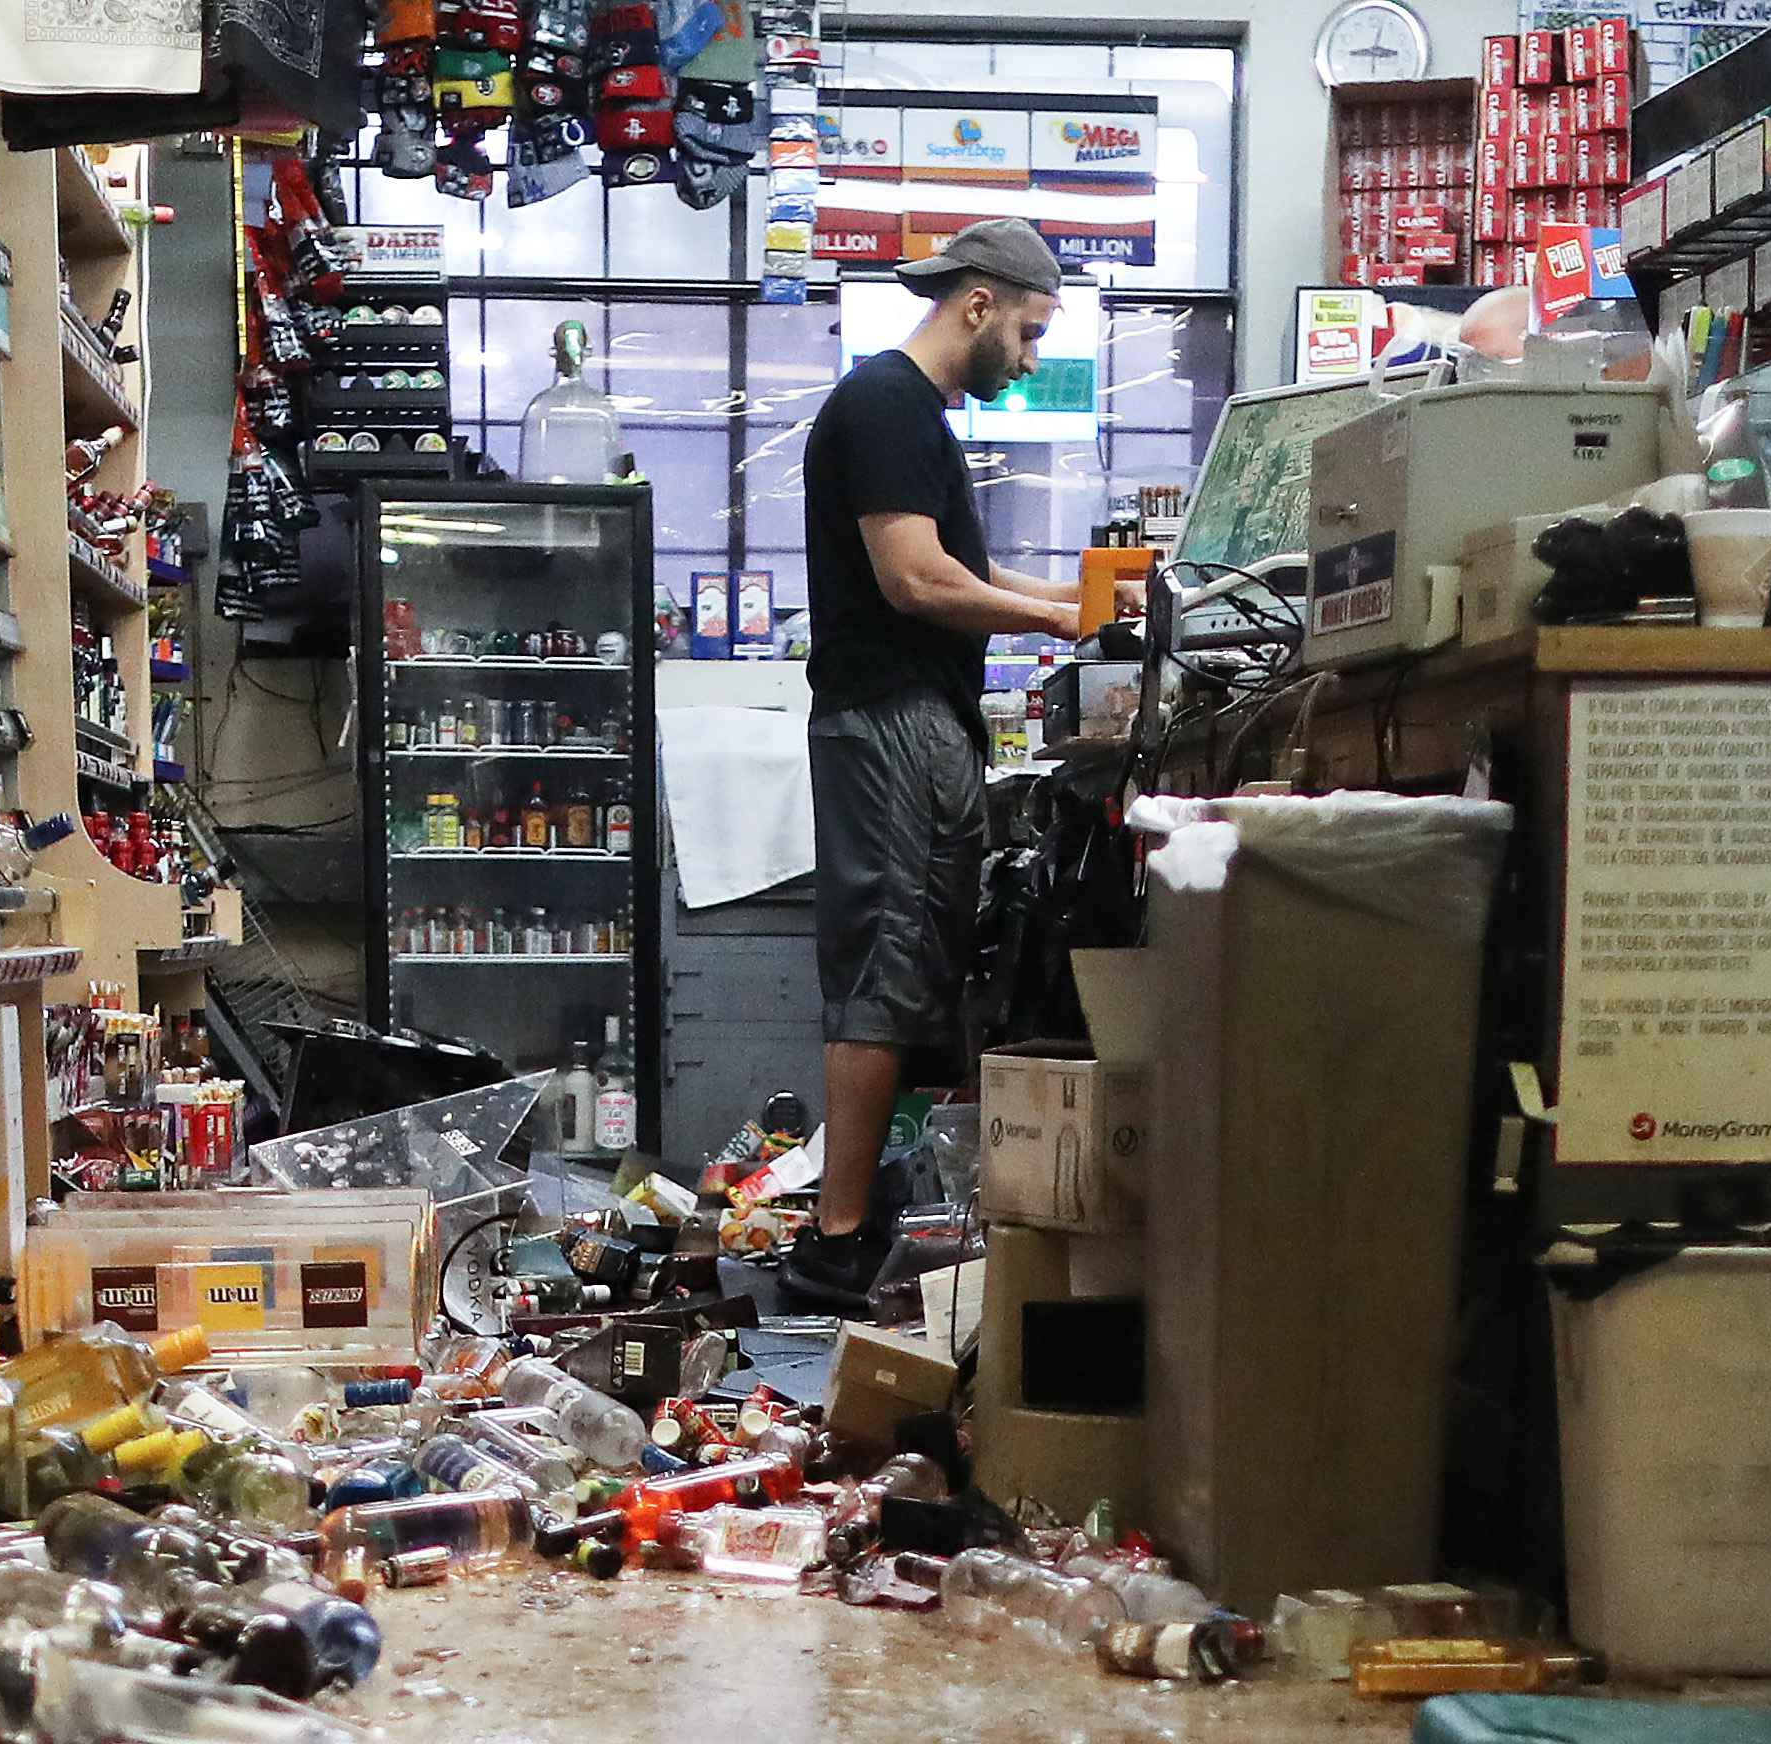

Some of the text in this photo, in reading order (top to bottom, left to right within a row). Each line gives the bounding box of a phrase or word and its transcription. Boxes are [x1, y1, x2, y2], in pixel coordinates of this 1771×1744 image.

[1491, 43, 1503, 85] CLASSIC
[1527, 36, 1540, 78] CLASSIC
[1574, 34, 1587, 76] CLASSIC
[1603, 24, 1615, 68] CLASSIC
[1488, 94, 1501, 136] CLASSIC
[1518, 93, 1529, 136] CLASSIC
[1549, 93, 1560, 134] CLASSIC
[1577, 88, 1588, 130] CLASSIC
[1604, 80, 1615, 125] CLASSIC
[1081, 124, 1139, 147] MEGA
[1484, 144, 1496, 186] CLASSIC
[1515, 142, 1527, 183] CLASSIC
[1546, 138, 1558, 180] CLASSIC
[1578, 140, 1589, 181] CLASSIC
[1606, 136, 1617, 179] CLASSIC
[1397, 216, 1439, 227] CLASSIC
[1482, 194, 1495, 236] CLASSIC
[1515, 197, 1525, 236] CLASSIC
[367, 232, 440, 248] DARK
[1059, 238, 1132, 256] MILLION
[1409, 247, 1450, 257] CLASSIC
[1377, 276, 1418, 286] CLASSIC
[1310, 342, 1358, 362] Card
[1315, 330, 1351, 347] We
[467, 1246, 483, 1325] VODKA
